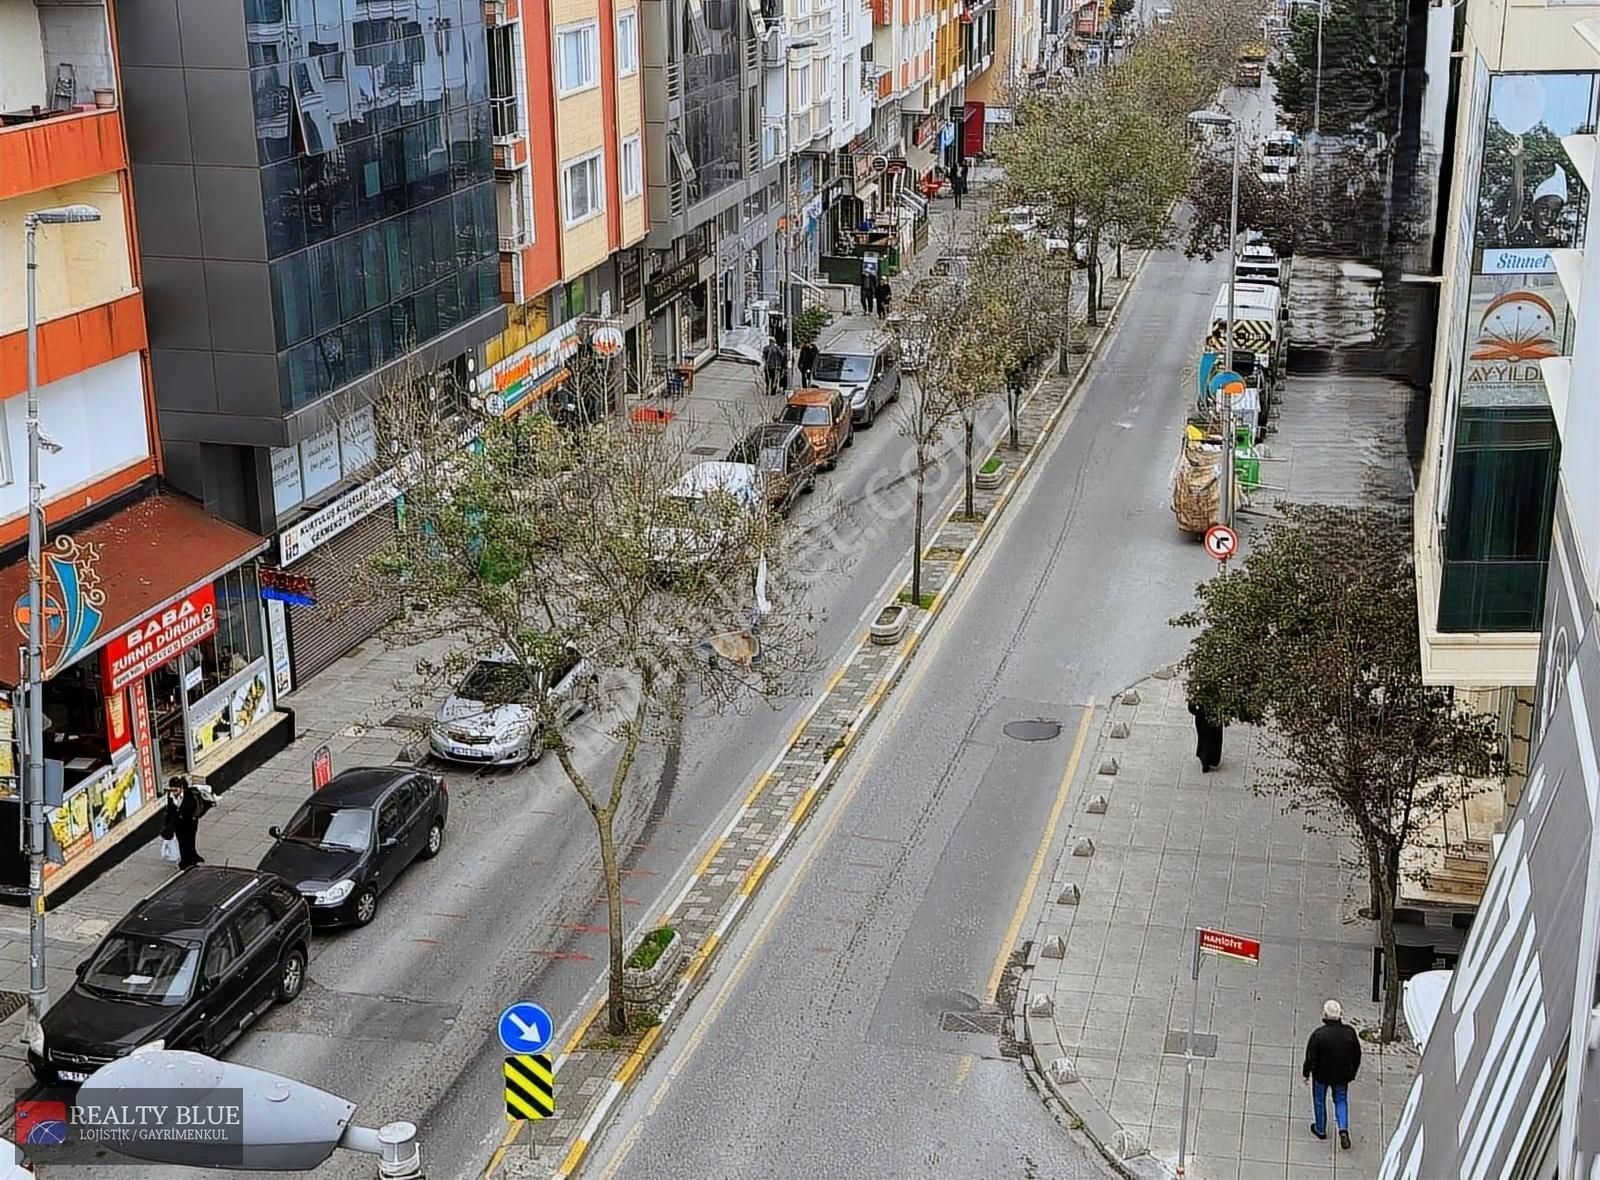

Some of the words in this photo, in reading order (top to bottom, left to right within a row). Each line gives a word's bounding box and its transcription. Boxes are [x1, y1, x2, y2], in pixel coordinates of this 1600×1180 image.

[112, 643, 153, 676] ZURNA
[157, 613, 200, 647] DÜRÜM
[127, 600, 195, 649] BABA
